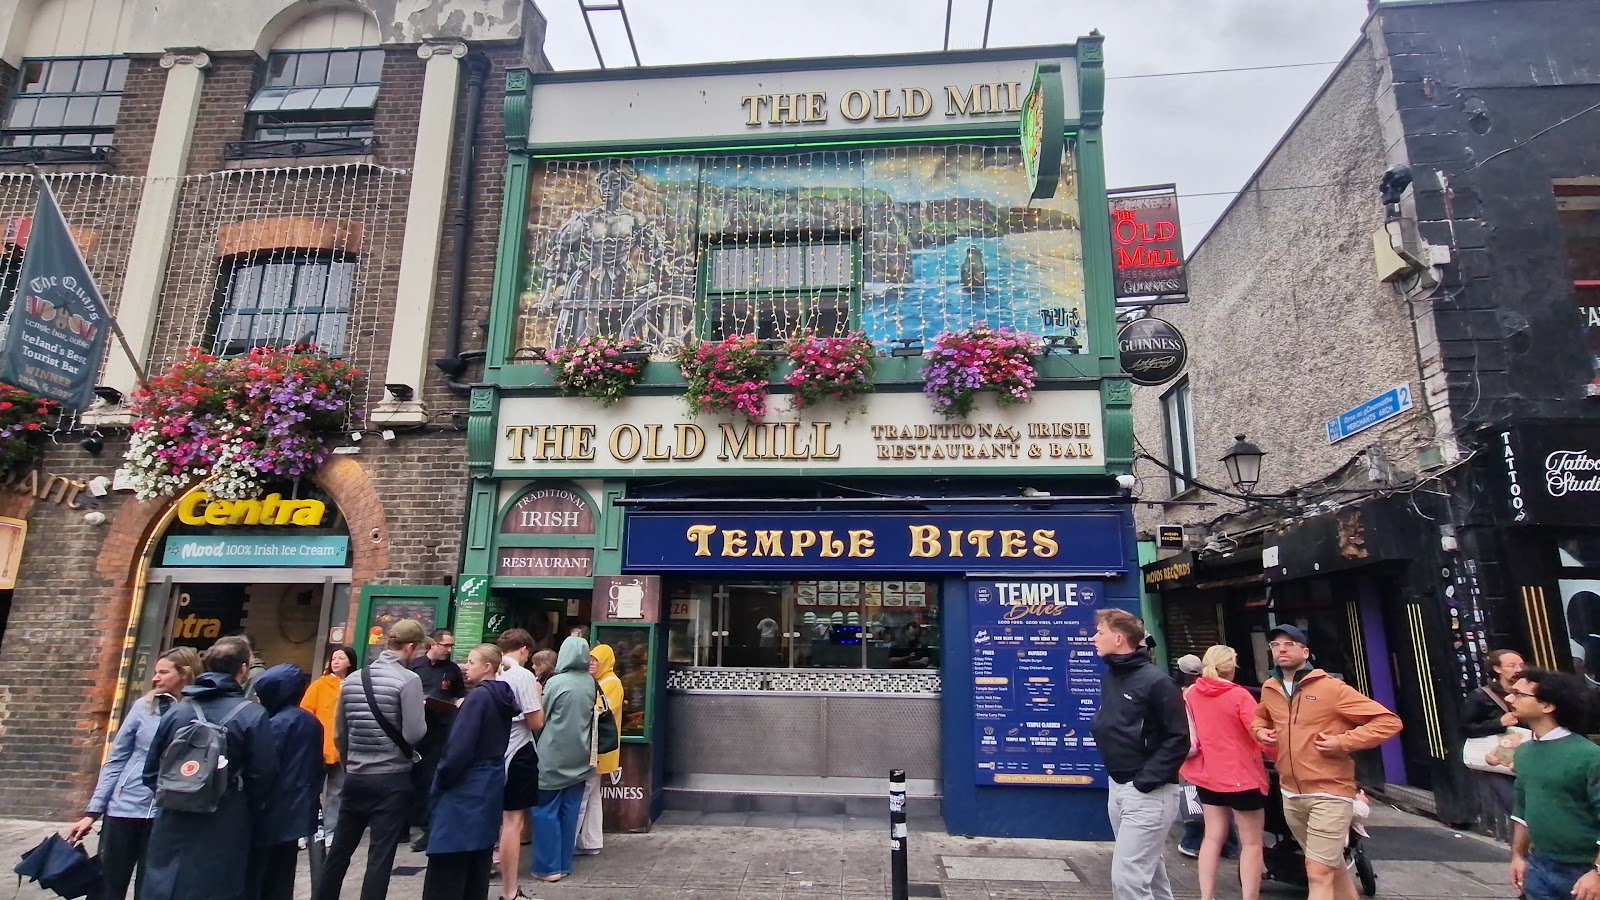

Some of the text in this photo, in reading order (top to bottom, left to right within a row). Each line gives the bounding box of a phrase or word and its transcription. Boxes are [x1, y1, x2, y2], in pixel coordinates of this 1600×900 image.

[742, 81, 1022, 126] THE OLD MIL
[1114, 209, 1135, 220] THE
[1115, 220, 1176, 245] OLD
[1116, 244, 1179, 269] MILL
[30, 275, 101, 321] The Quays
[1123, 279, 1181, 294] GUINNESS
[21, 330, 88, 365] Ireland's Best
[1119, 338, 1181, 353] GUINNESS
[22, 345, 79, 375] Tourist Bar
[25, 364, 72, 388] WINNER
[1400, 387, 1410, 406] 2
[1378, 405, 1394, 417] ARCH
[506, 421, 841, 461] THE OLD MILL
[871, 422, 1091, 443] TRADITIONAL IRISH
[877, 442, 1094, 459] RESTAURANT & BAR
[1500, 431, 1524, 510] TATTOO
[178, 491, 326, 526] Centra
[515, 488, 586, 511] TRADITIONAL
[520, 511, 580, 527] IRISH
[181, 541, 335, 560] Mood 100% Irish Ice Cream
[502, 557, 590, 568] RESTAURANT
[1163, 562, 1191, 580] RECORDS
[994, 582, 1079, 606] TEMPLE
[1003, 599, 1068, 620] Bites
[131, 655, 148, 691] ATM
